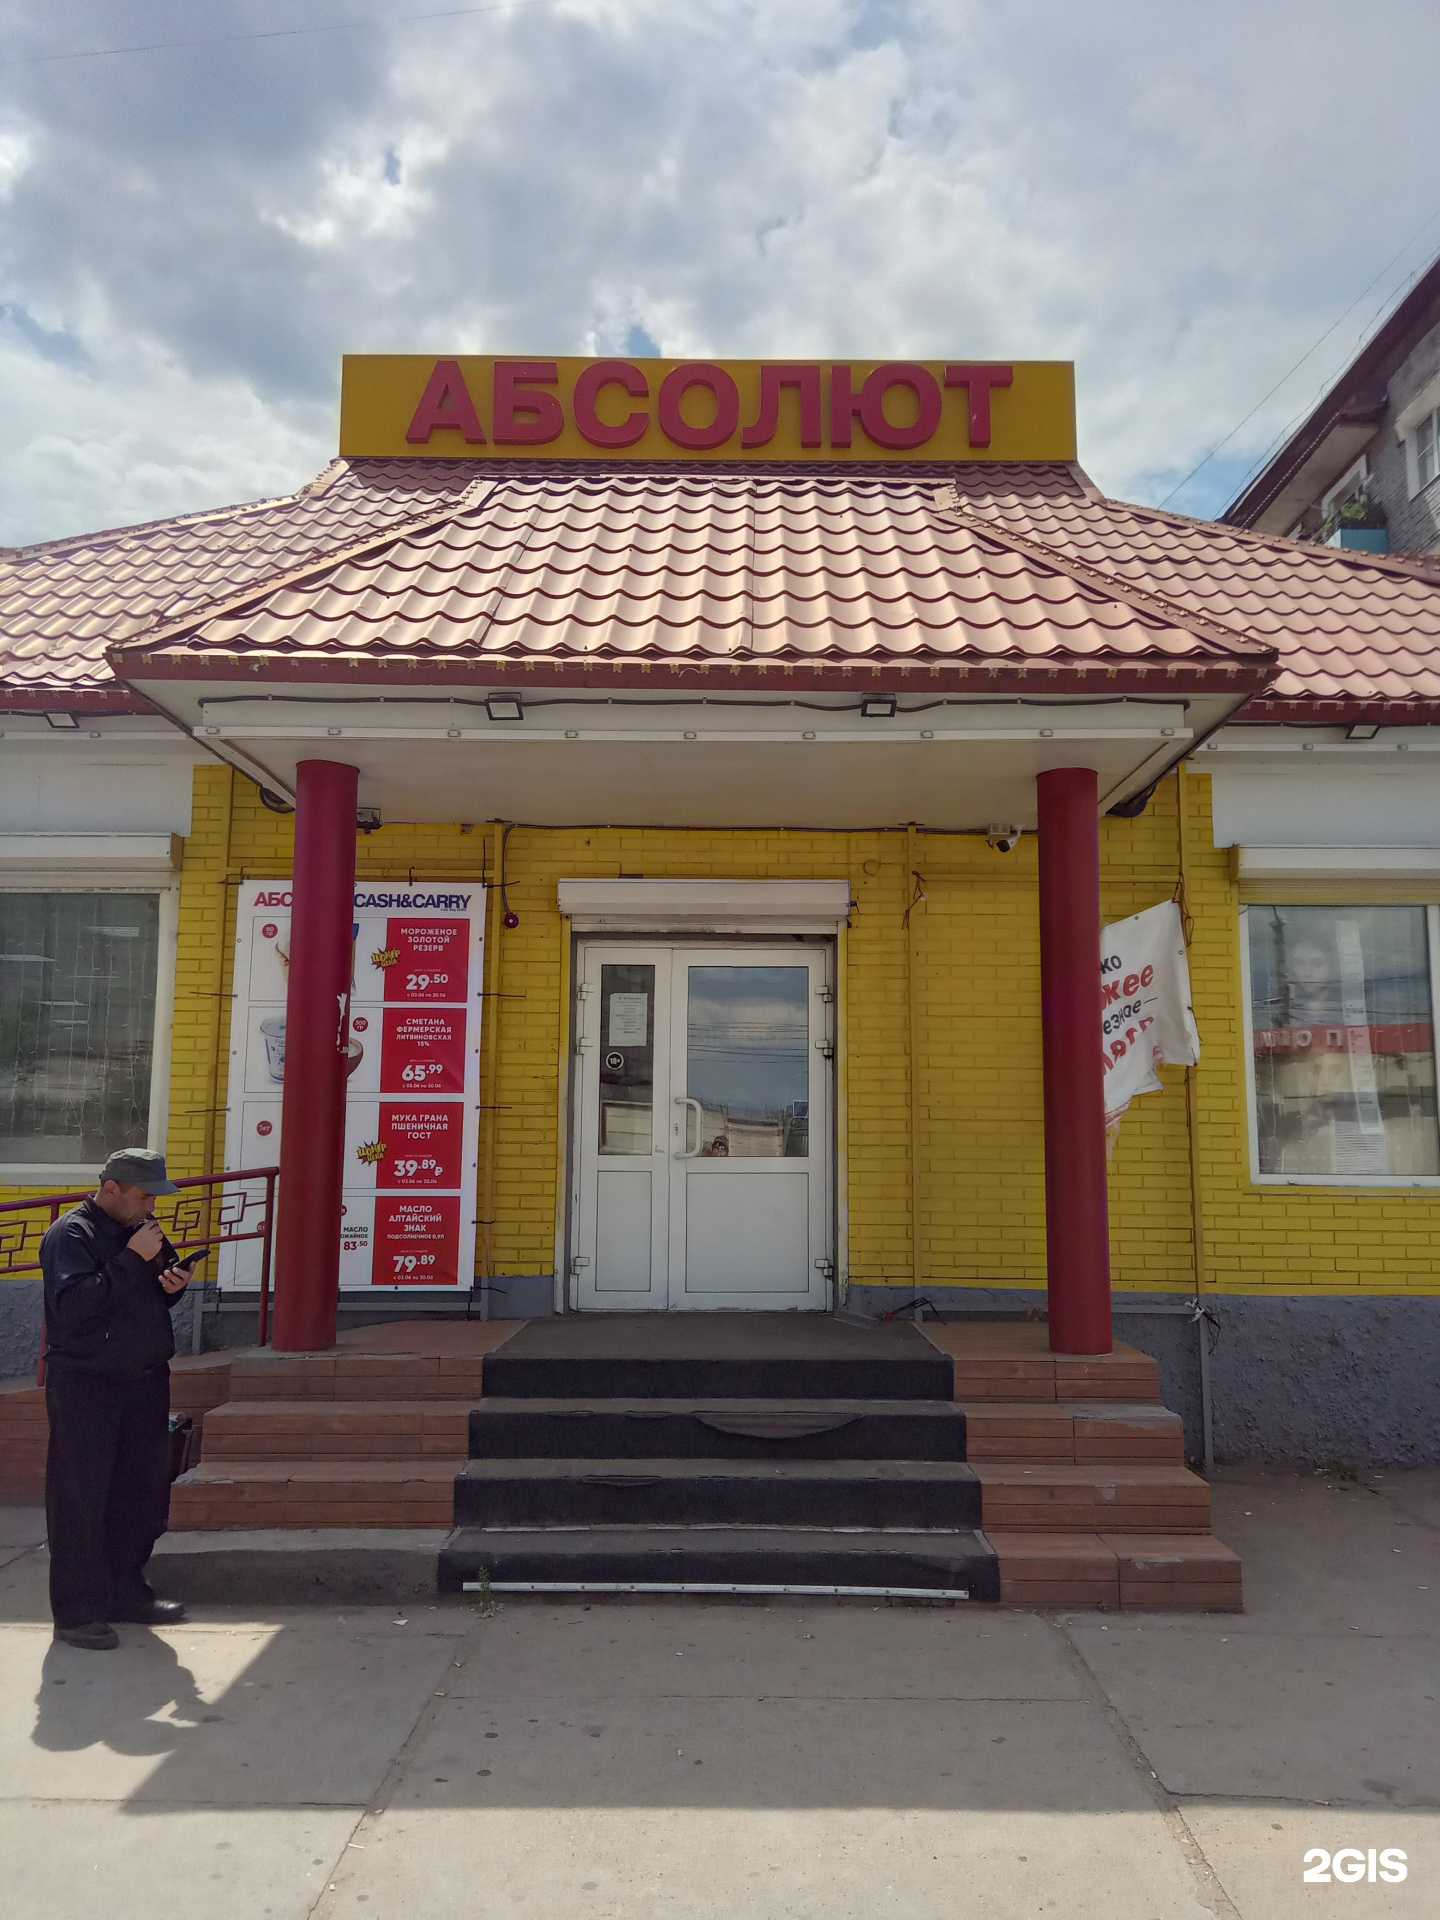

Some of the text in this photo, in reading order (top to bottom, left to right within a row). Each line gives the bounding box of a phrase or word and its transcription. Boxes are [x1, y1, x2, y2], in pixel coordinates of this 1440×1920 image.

[405, 359, 1013, 449] АБСОЛЮТ
[354, 893, 472, 909] CASH&CARRY
[400, 928, 457, 936] МОРОЖЕНОЕ
[407, 936, 450, 944] ЗОЛОТОЙ
[405, 973, 449, 991] 29.50
[402, 1064, 443, 1081] 65.99
[399, 1205, 432, 1213] МАСЛО
[389, 1213, 442, 1222] АЛТАЙСКИЙ
[343, 1241, 368, 1250] 83.50
[392, 1255, 436, 1272] 79.89
